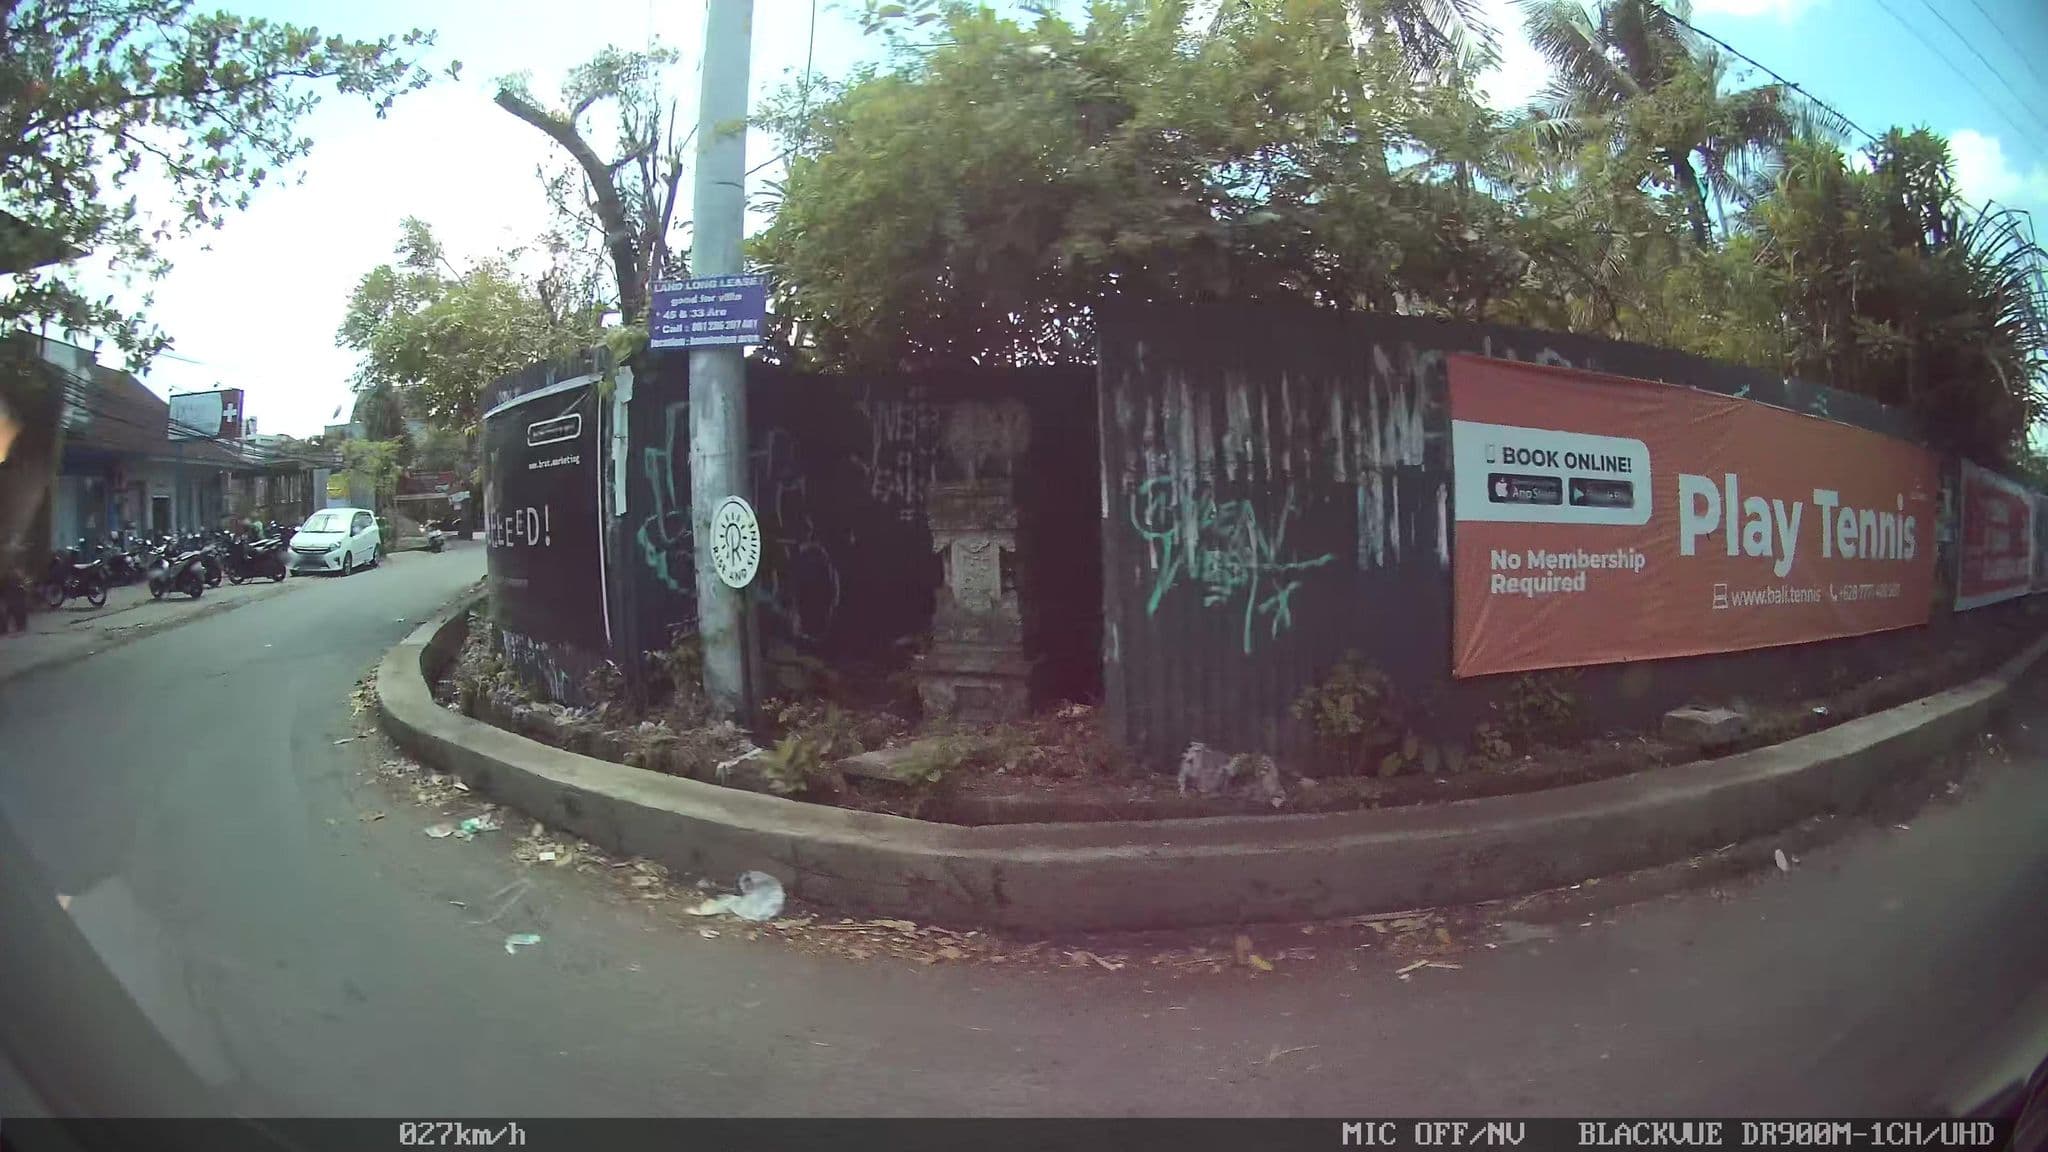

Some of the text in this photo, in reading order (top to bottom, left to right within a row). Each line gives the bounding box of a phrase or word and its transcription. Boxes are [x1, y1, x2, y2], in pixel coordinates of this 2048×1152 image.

[654, 277, 758, 293] LAND LONG LEASE
[671, 295, 698, 307] good
[700, 294, 716, 303] for
[1502, 446, 1632, 474] BOOK ONLINE!
[1678, 473, 1803, 578] Play
[1813, 488, 1916, 560] Tennis
[1490, 548, 1646, 573] No Membership
[1490, 571, 1587, 599] Required
